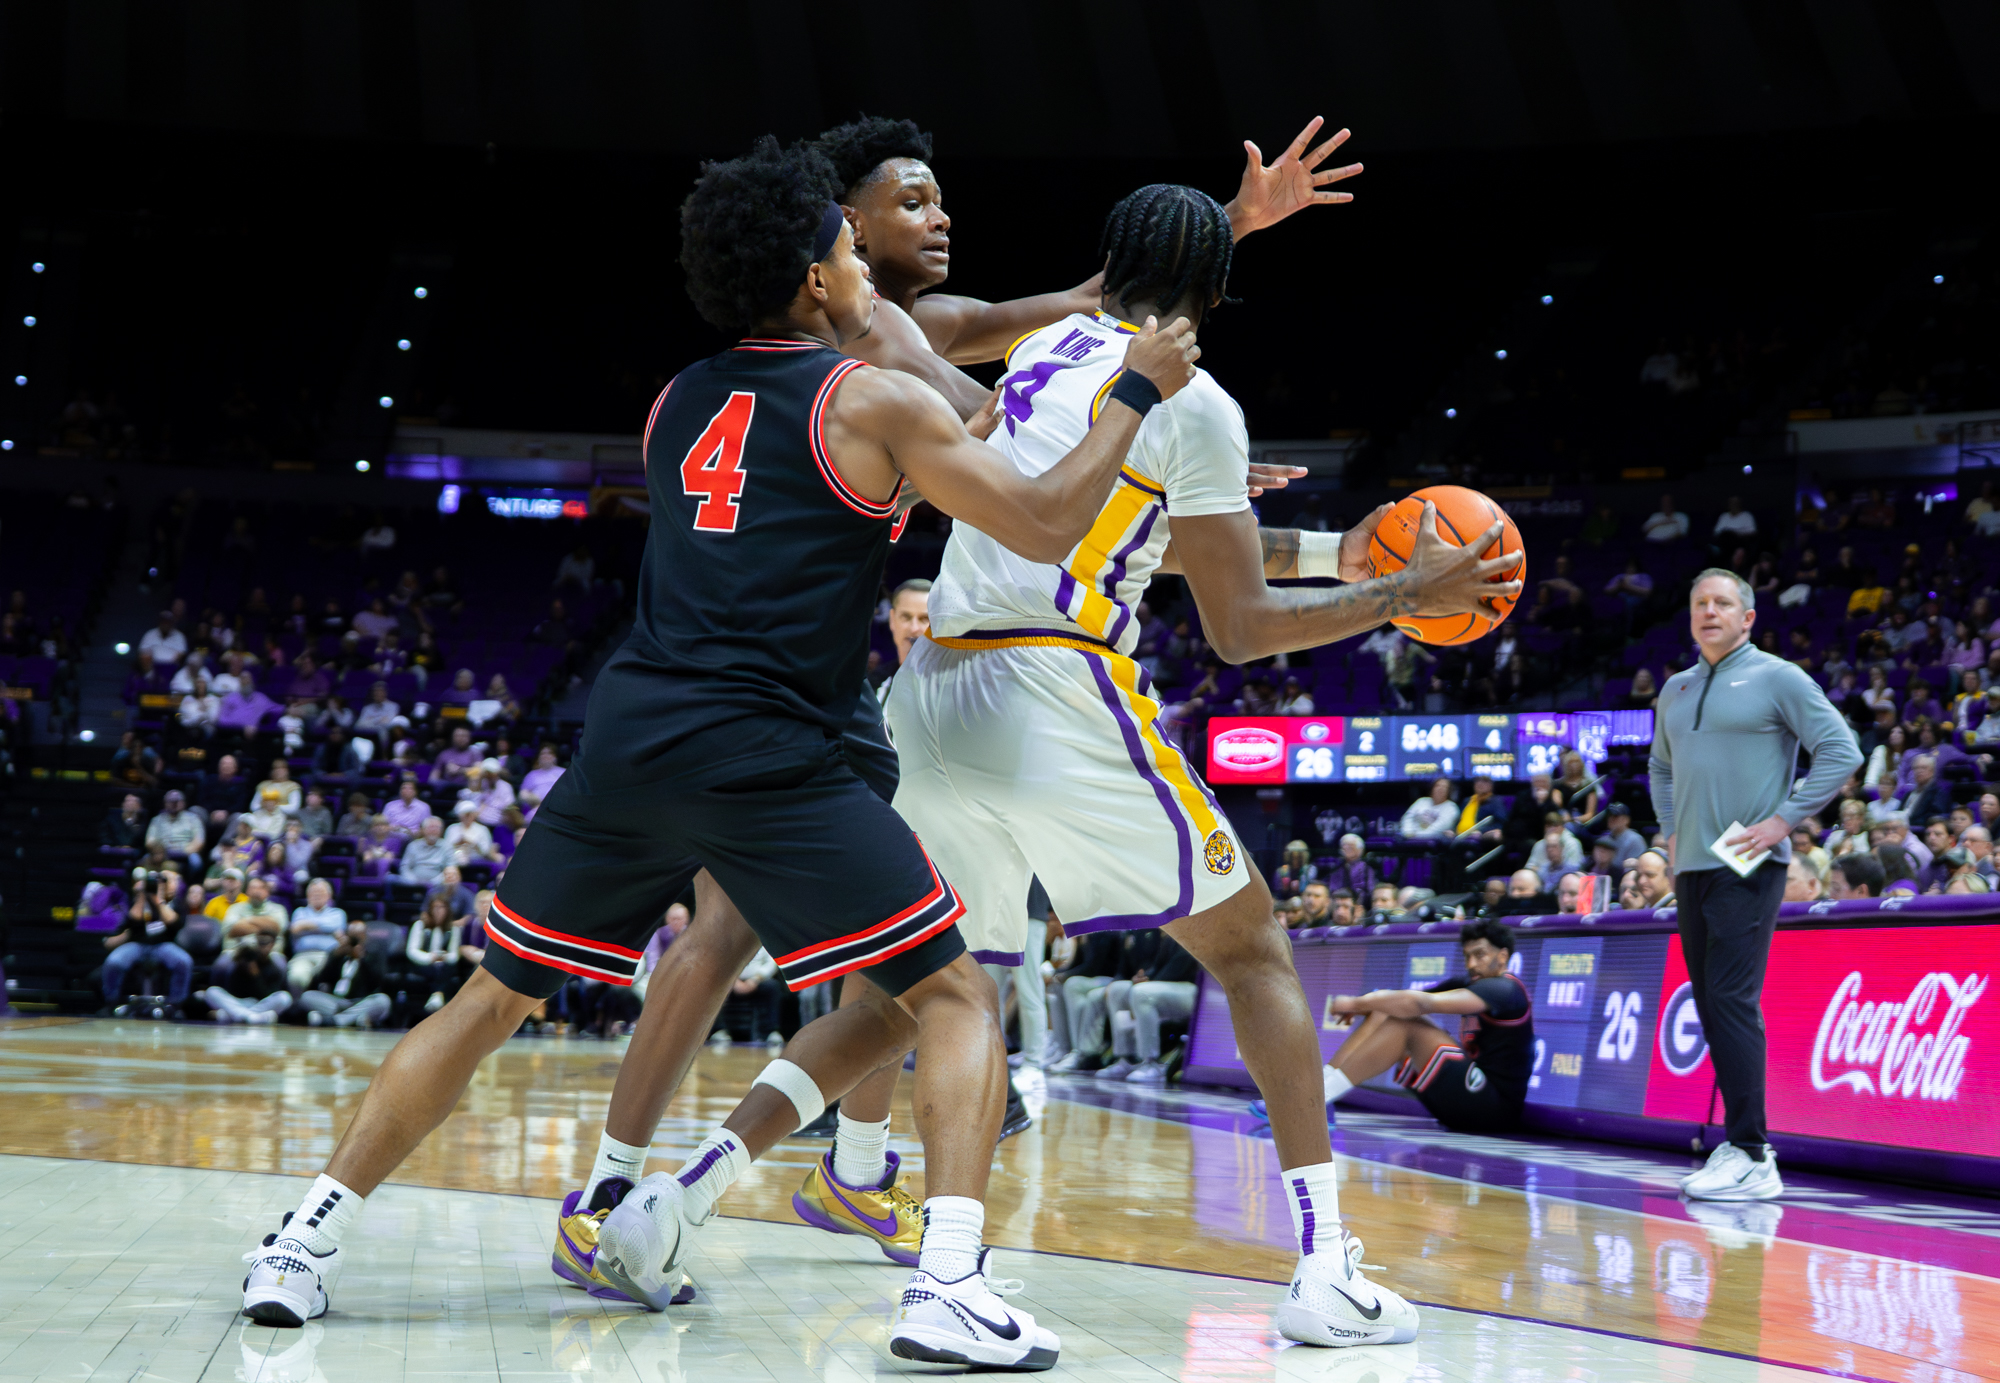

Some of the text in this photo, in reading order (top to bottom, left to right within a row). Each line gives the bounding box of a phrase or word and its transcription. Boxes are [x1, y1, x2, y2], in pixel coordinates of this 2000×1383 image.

[1049, 328, 1106, 362] KING
[1004, 362, 1066, 438] 4
[680, 390, 755, 532] 4
[1359, 731, 1375, 753] 2
[1485, 729, 1501, 751] 4
[1295, 747, 1334, 778] 26
[1441, 757, 1454, 774] 1
[1597, 991, 1642, 1061] 26
[279, 1241, 302, 1254] GIGI
[908, 1274, 926, 1284] GIGI
